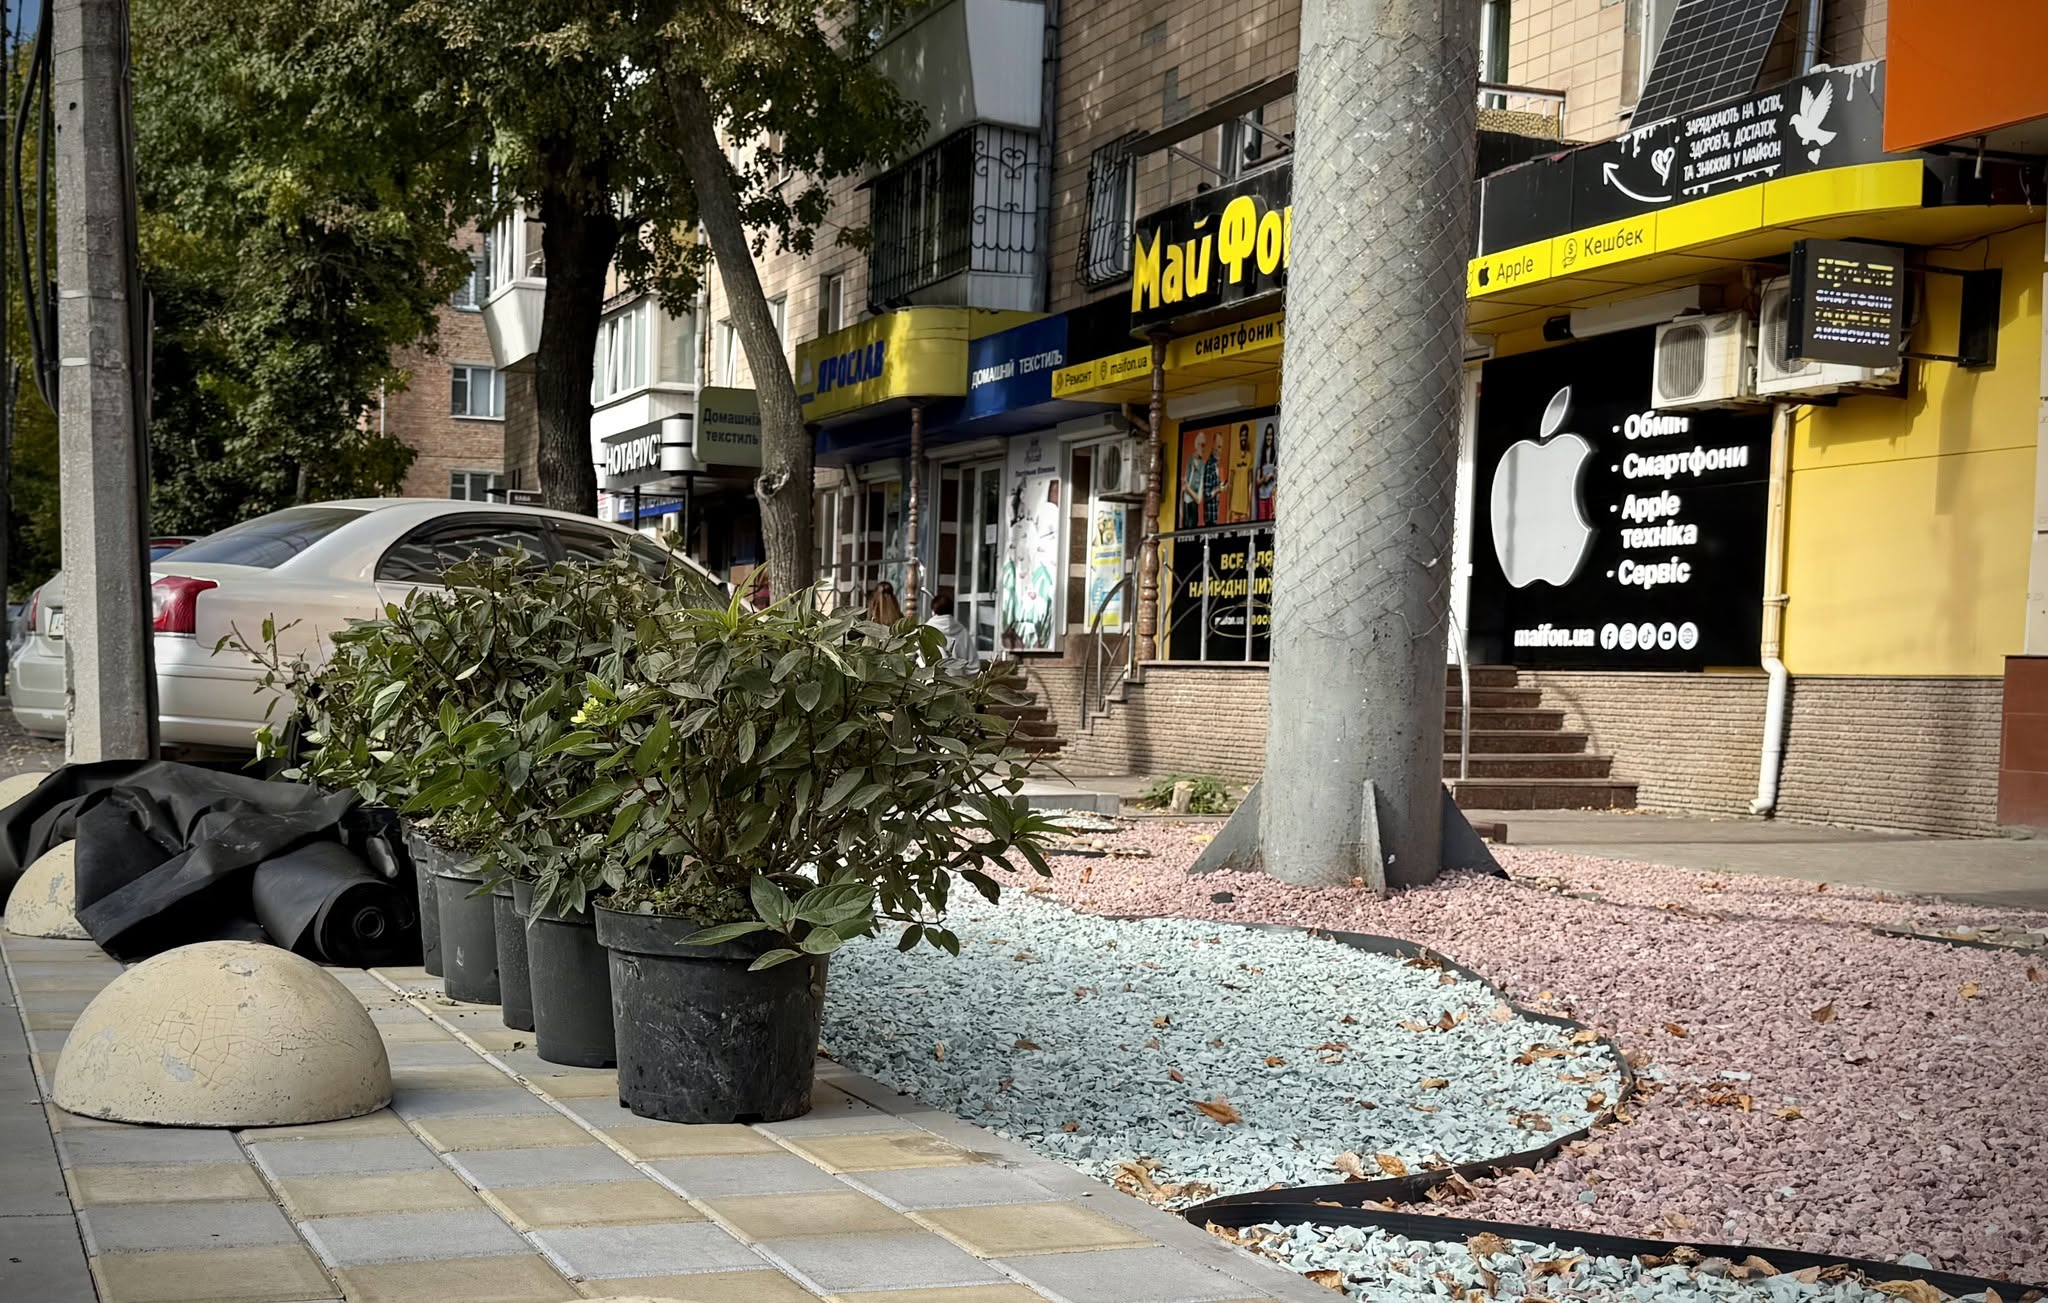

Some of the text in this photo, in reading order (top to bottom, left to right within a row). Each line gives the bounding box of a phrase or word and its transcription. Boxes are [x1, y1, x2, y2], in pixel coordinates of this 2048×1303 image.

[1685, 94, 1784, 137] ЗАРЯДЖАЮТЬ НА УСПІХ,
[1684, 140, 1781, 181] ТА ЗНИЖКИ У МАЙФОН
[1584, 228, 1643, 257] Кешбек
[1496, 256, 1533, 283] Apple
[1196, 319, 1274, 355] смартфони
[817, 340, 885, 394] ЯРОСЛАВ
[971, 350, 1063, 389] ДОМАШНІЙ ТЕКСТИЛЬ
[1065, 371, 1092, 387] Ремонт
[1110, 356, 1147, 375] maifon.ua
[705, 430, 759, 445] текстиль
[1624, 410, 1689, 440] Обмін
[1622, 445, 1749, 480] Смартфони
[1621, 489, 1681, 523] Apple
[1620, 519, 1698, 549] техніка
[1618, 556, 1691, 590] Сервіс
[1514, 623, 1595, 647] maifon.ua
